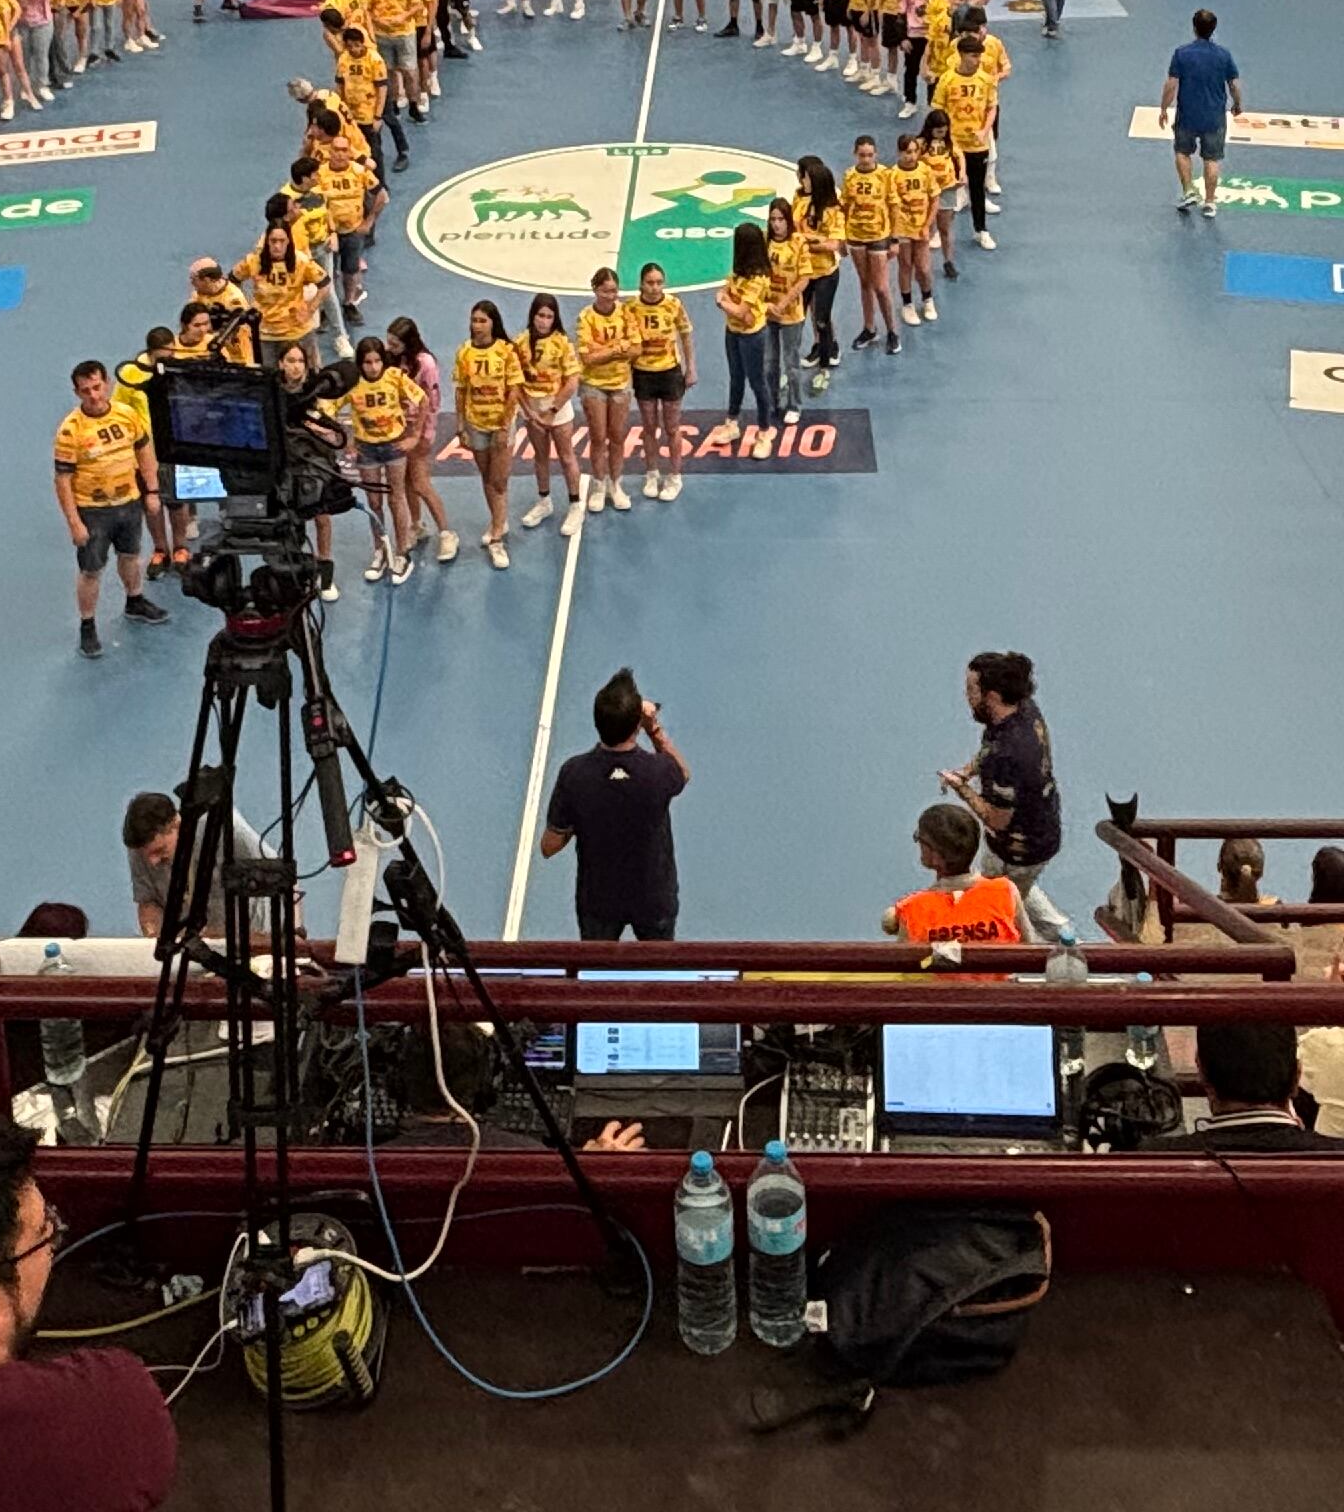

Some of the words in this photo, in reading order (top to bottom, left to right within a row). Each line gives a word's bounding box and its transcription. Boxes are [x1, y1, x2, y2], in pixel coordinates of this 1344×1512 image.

[959, 84, 977, 98] 37
[856, 181, 872, 195] 22
[438, 227, 612, 244] plenitude
[642, 314, 659, 330] 15
[602, 325, 618, 340] 17
[474, 359, 491, 377] 71
[364, 391, 388, 409] 82
[97, 423, 125, 446] 98
[927, 920, 1000, 943] PRENSA
